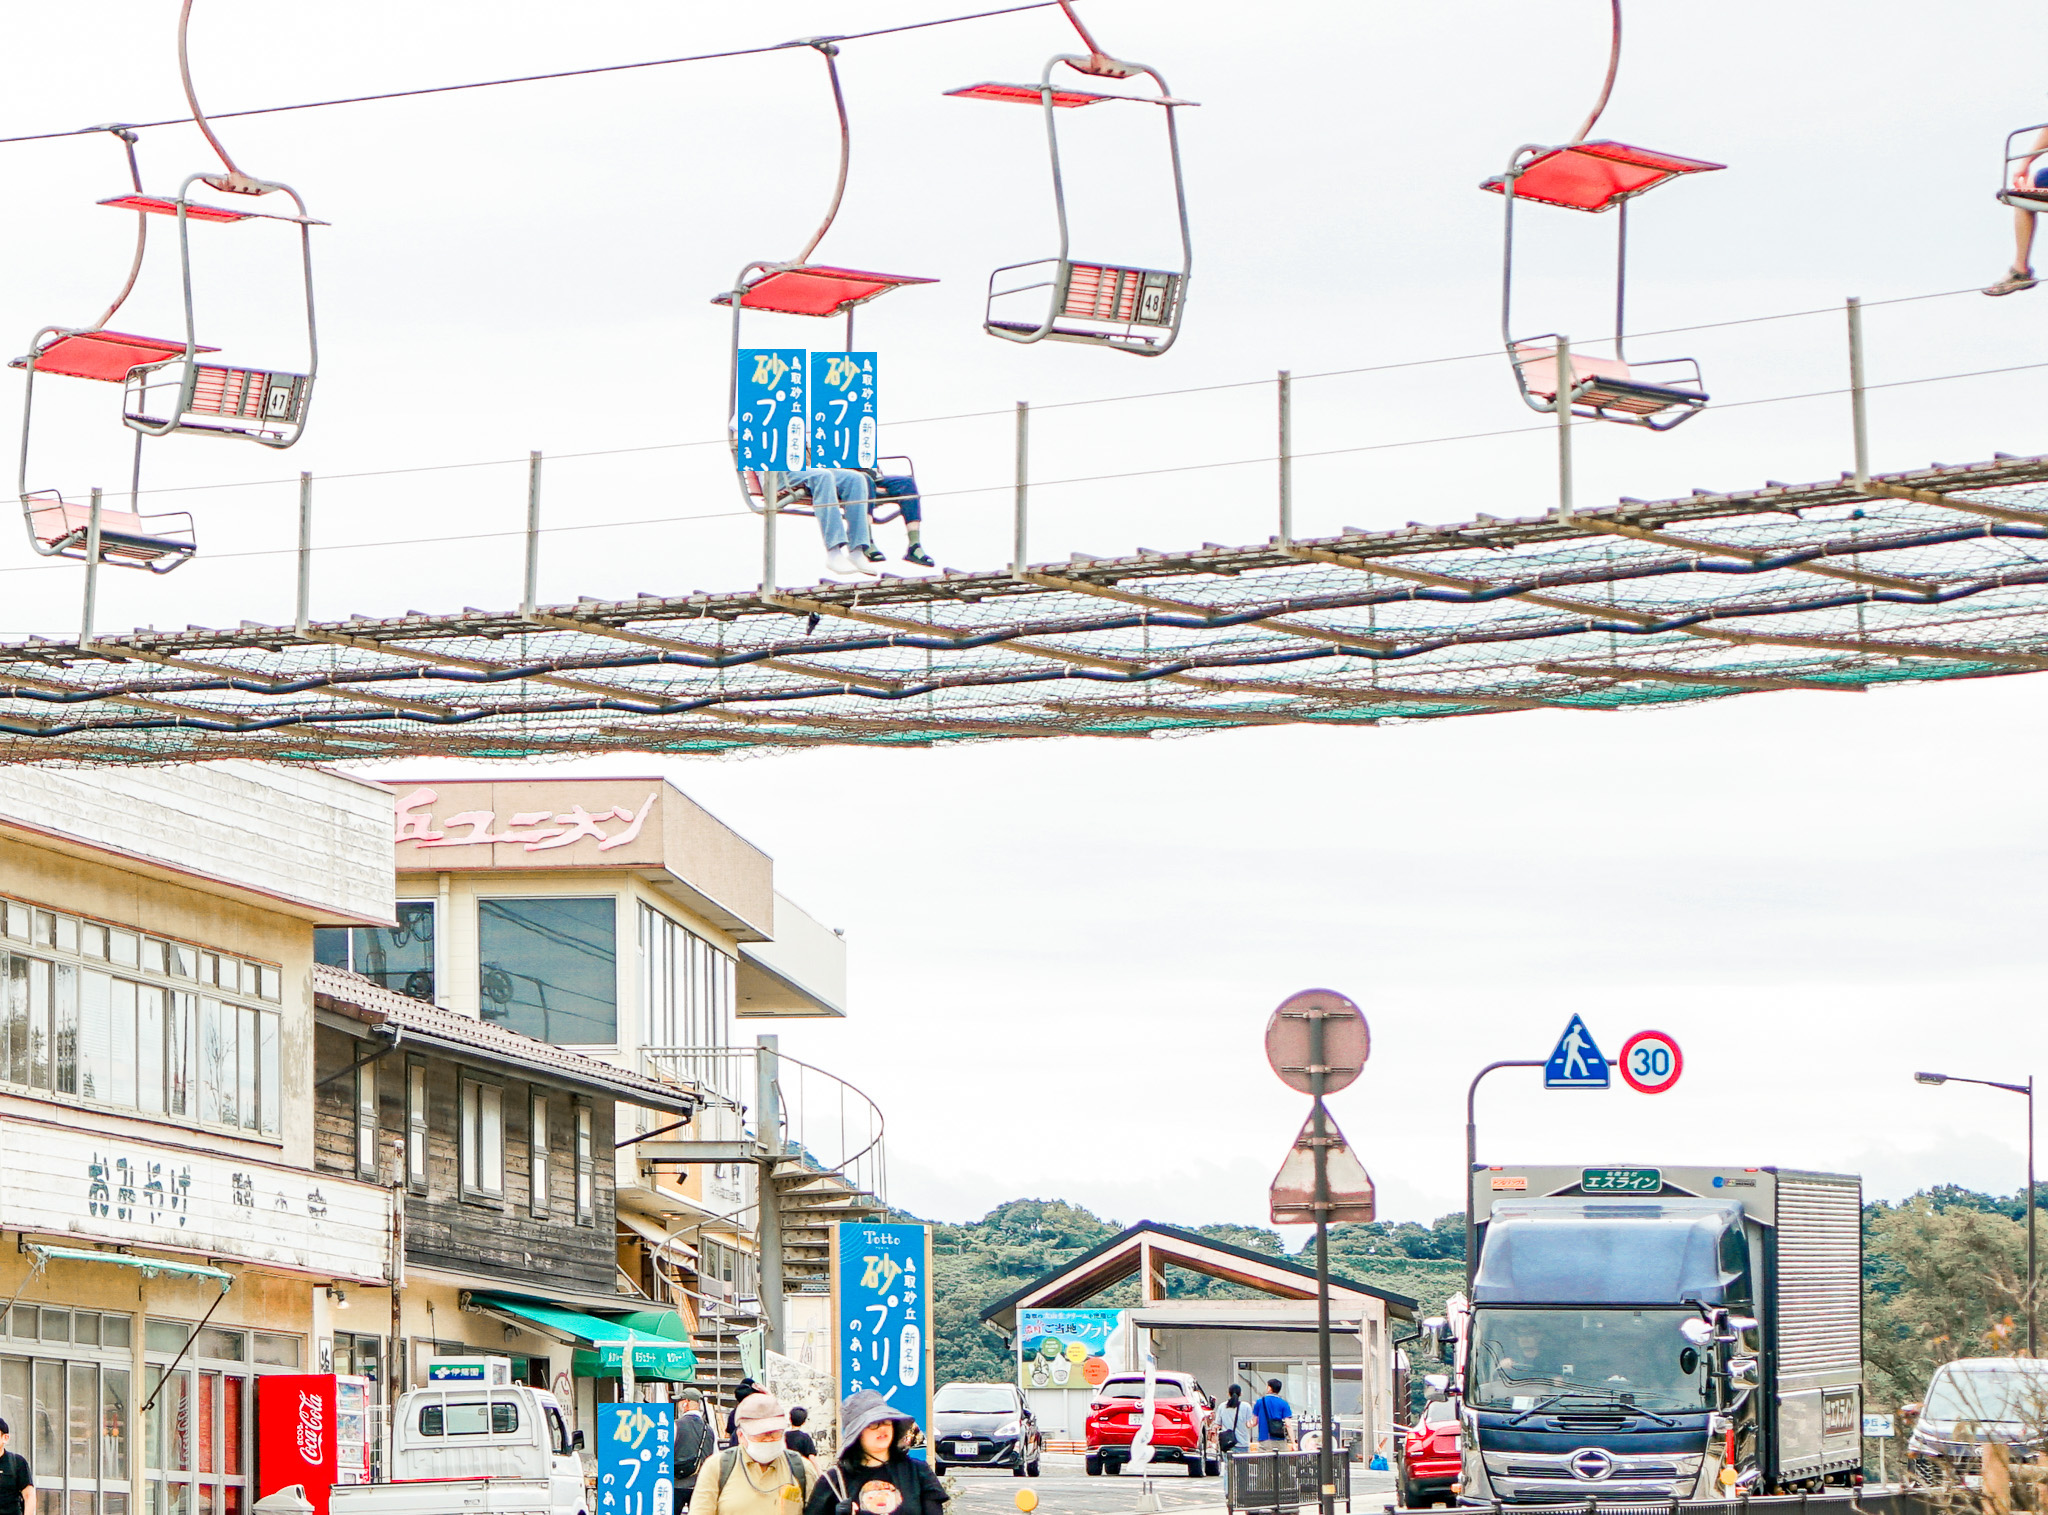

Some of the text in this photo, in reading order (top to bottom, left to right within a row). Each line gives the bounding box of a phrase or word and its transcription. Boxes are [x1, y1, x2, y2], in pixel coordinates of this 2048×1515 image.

[1145, 294, 1160, 312] 48
[271, 394, 286, 410] 47
[789, 355, 803, 413] 鳥取砂丘
[860, 358, 874, 413] 鳥取砂丘
[751, 352, 790, 471] 砂プリ
[824, 354, 861, 468] 砂プリ
[1634, 1048, 1670, 1076] 30
[1585, 1177, 1656, 1189] エスライン
[863, 1230, 901, 1246] Totto
[903, 1256, 918, 1320] 鳥取砂丘
[903, 1332, 916, 1379] 新名物
[299, 1390, 323, 1465] Coca-Cola
[655, 1411, 671, 1474] 鳥取砂丘
[602, 1473, 616, 1515] のあ
